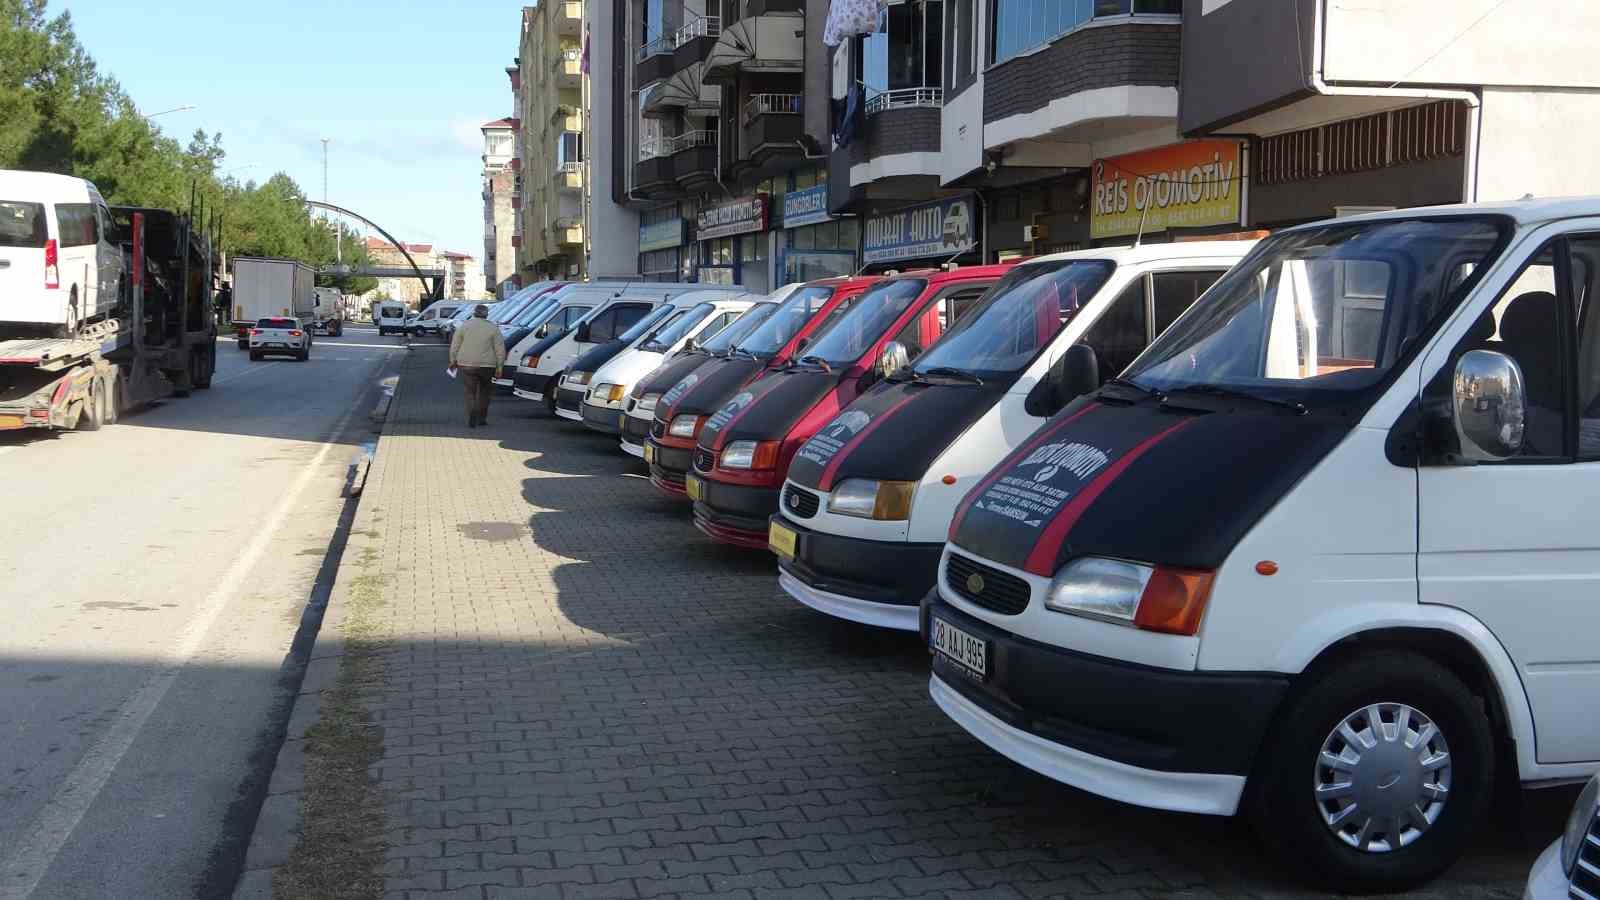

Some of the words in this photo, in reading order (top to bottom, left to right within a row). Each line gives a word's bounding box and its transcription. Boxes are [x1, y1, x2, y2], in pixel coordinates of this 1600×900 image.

[1095, 171, 1128, 216] REİS
[1134, 152, 1234, 212] OTOMOTİV
[911, 206, 942, 242] AUTO
[935, 621, 945, 648] 28
[948, 627, 964, 659] AAJ
[966, 637, 984, 670] 995
